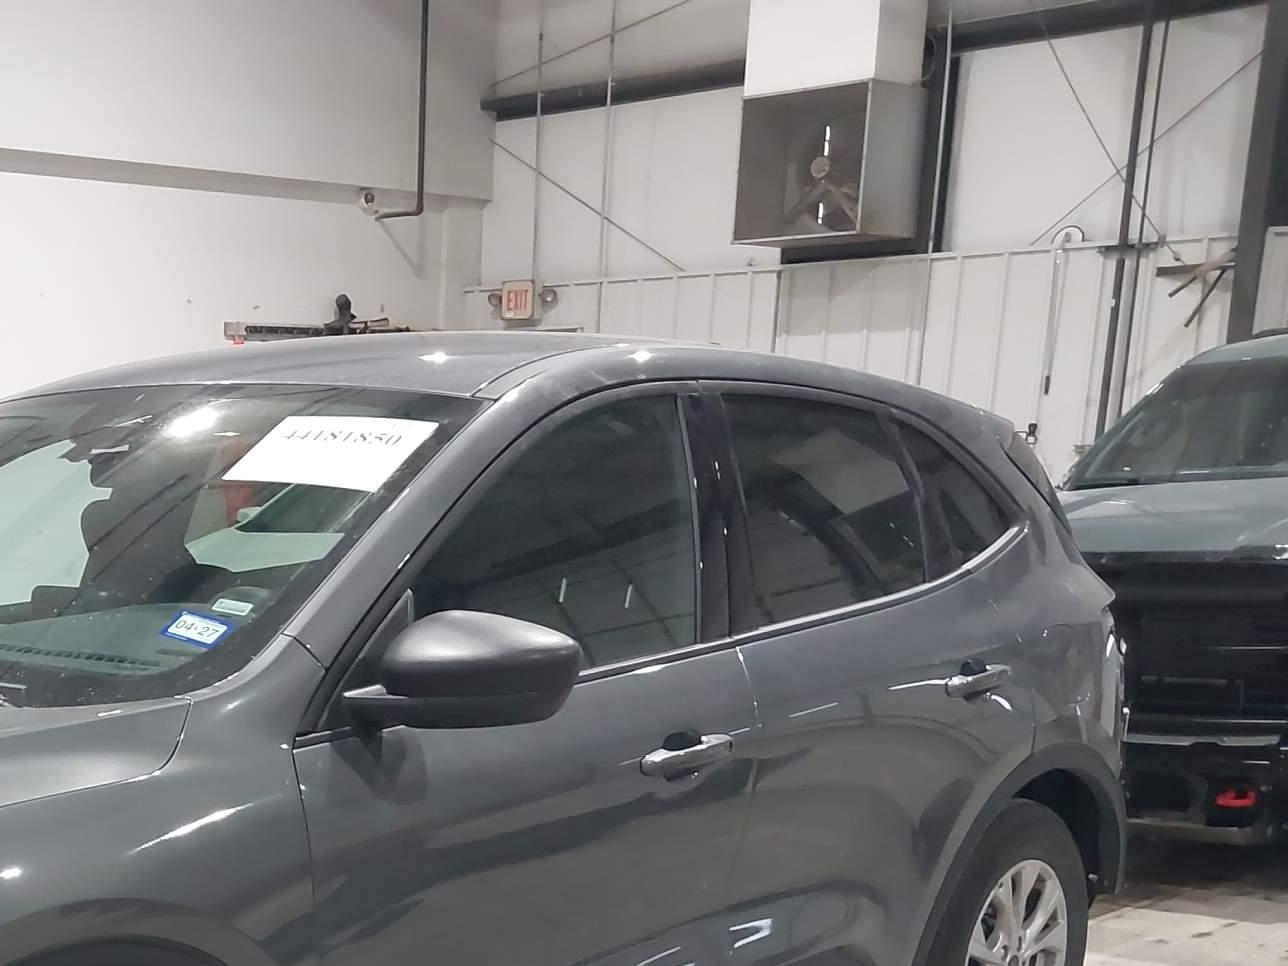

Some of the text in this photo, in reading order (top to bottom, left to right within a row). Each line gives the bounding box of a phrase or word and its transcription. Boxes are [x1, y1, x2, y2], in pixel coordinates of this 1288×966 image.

[507, 289, 528, 311] EXIT
[282, 430, 403, 446] 44181850
[198, 626, 220, 638] 27
